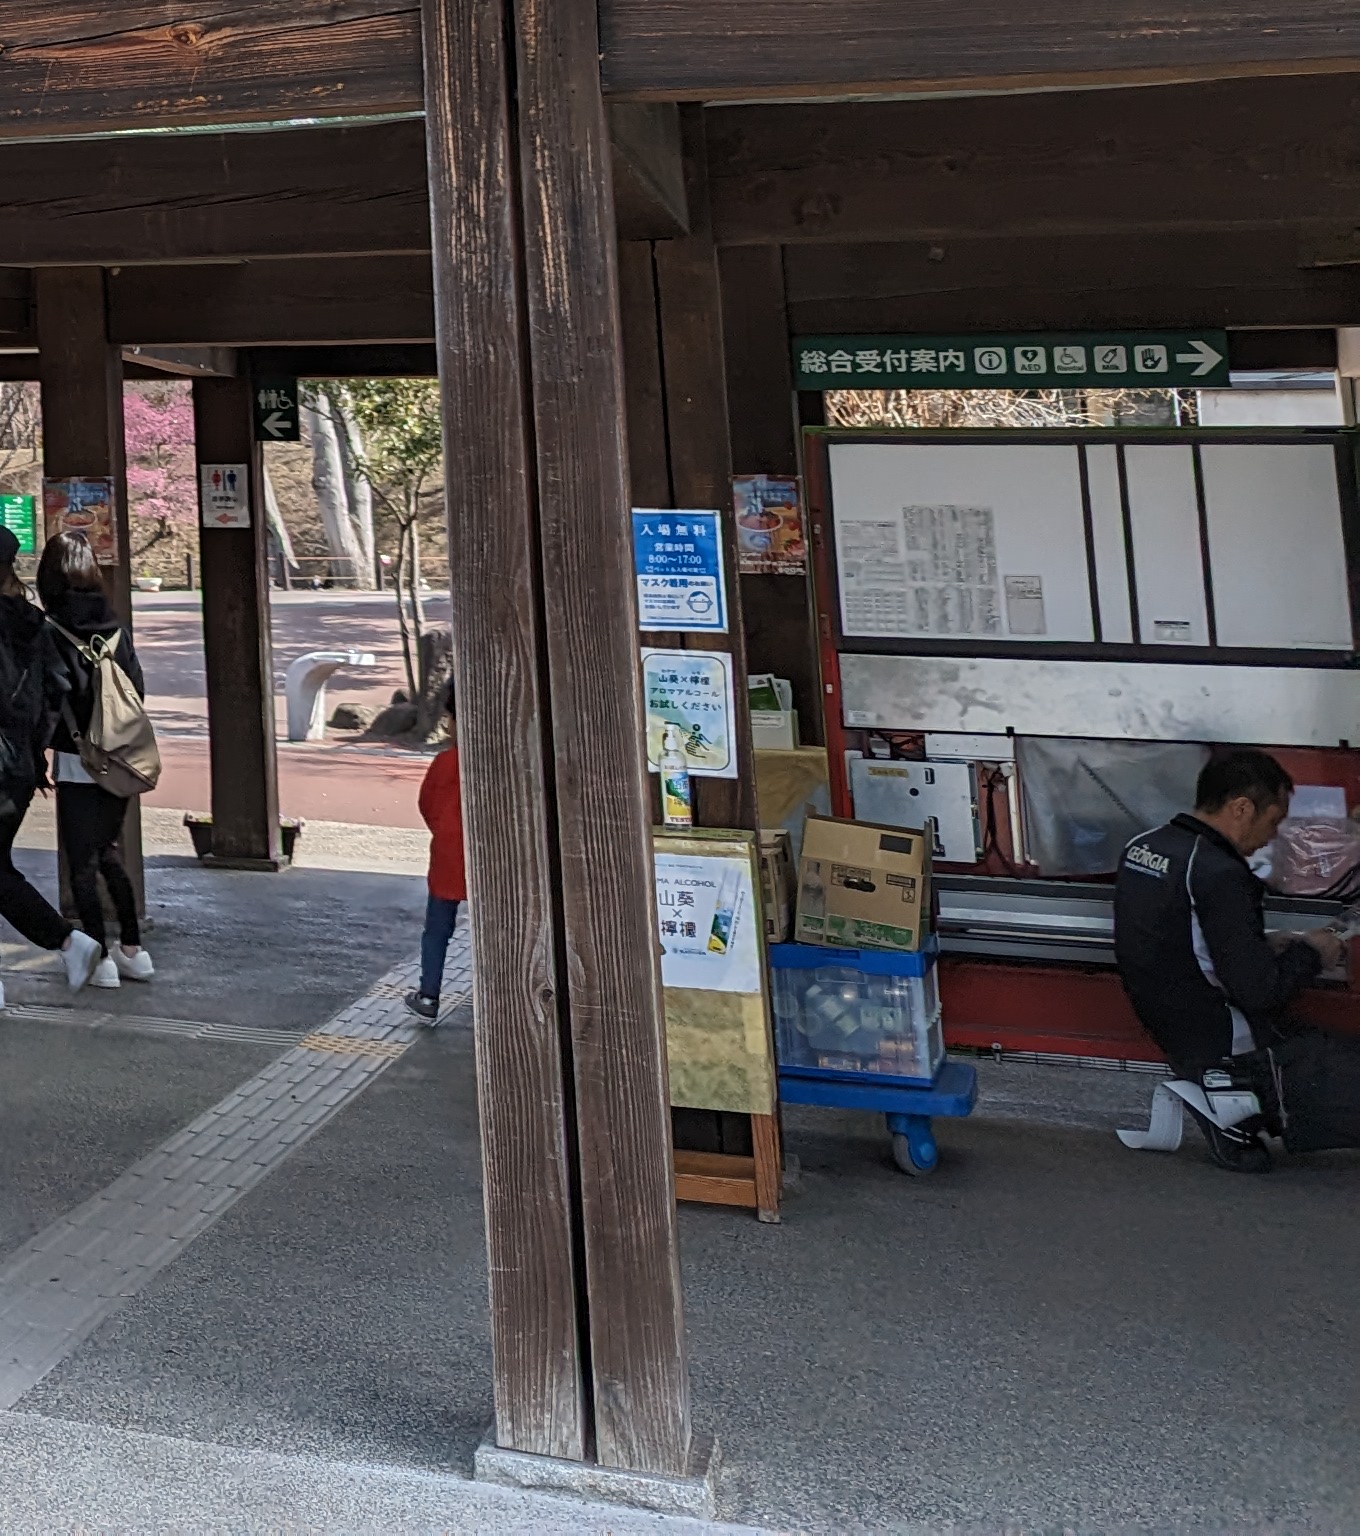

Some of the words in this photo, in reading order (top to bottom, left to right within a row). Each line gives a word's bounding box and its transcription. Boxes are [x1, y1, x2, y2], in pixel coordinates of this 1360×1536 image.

[800, 350, 965, 374] 総合受付案内
[641, 524, 706, 536] 入場無料
[654, 543, 695, 552] 営業時間
[650, 687, 720, 698] アロマアルコール
[650, 700, 722, 711] お試しください
[1127, 846, 1170, 873] GEORGIA
[674, 879, 717, 888] ALCOHOL
